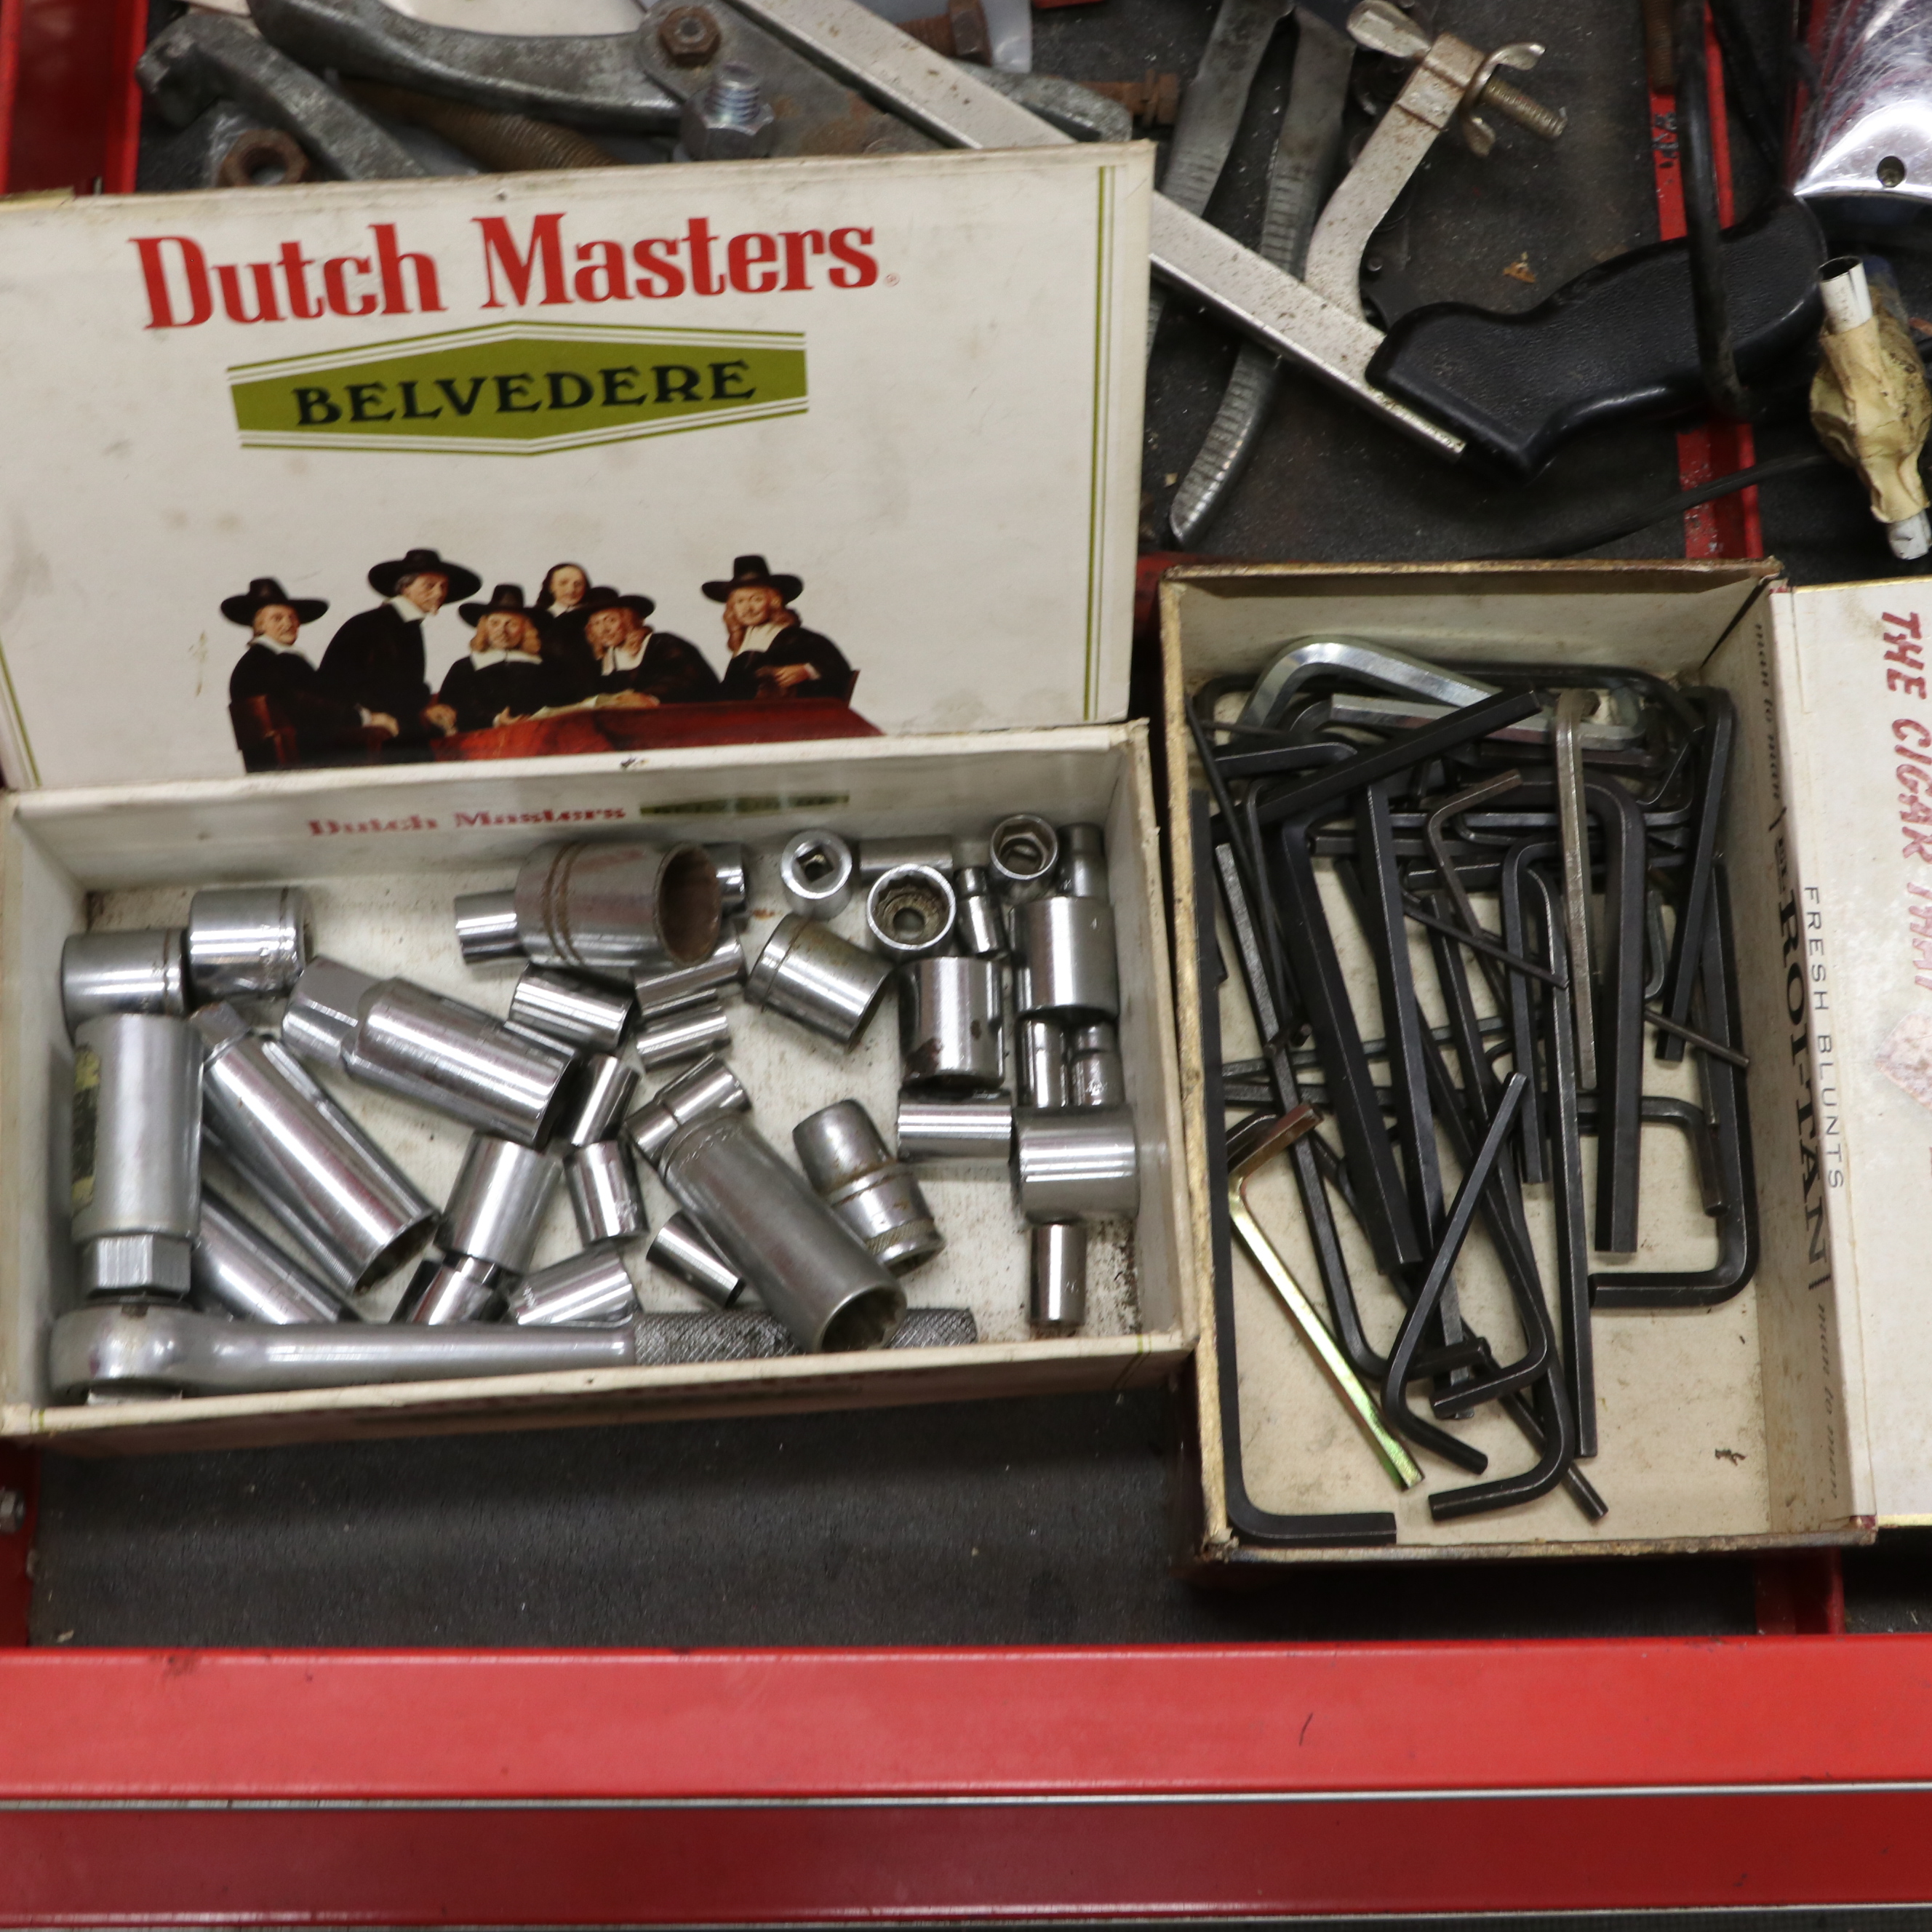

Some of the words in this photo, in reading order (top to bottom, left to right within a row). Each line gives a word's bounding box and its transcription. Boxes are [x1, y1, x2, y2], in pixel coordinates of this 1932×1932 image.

[127, 222, 449, 330] Dutch
[472, 212, 879, 308] Masters
[292, 359, 757, 426] BELVEDERE
[1882, 612, 1927, 700] THE
[308, 814, 439, 837] Dutch
[454, 807, 627, 829] Masters
[1891, 719, 1932, 864] CIGAR
[1779, 888, 1827, 1264] ROI-TAN
[1804, 886, 1829, 1010] FRESH
[1818, 1034, 1844, 1188] BLUNTS
[1819, 1303, 1830, 1376] man
[1824, 1386, 1834, 1415] to
[1827, 1424, 1837, 1498] man
